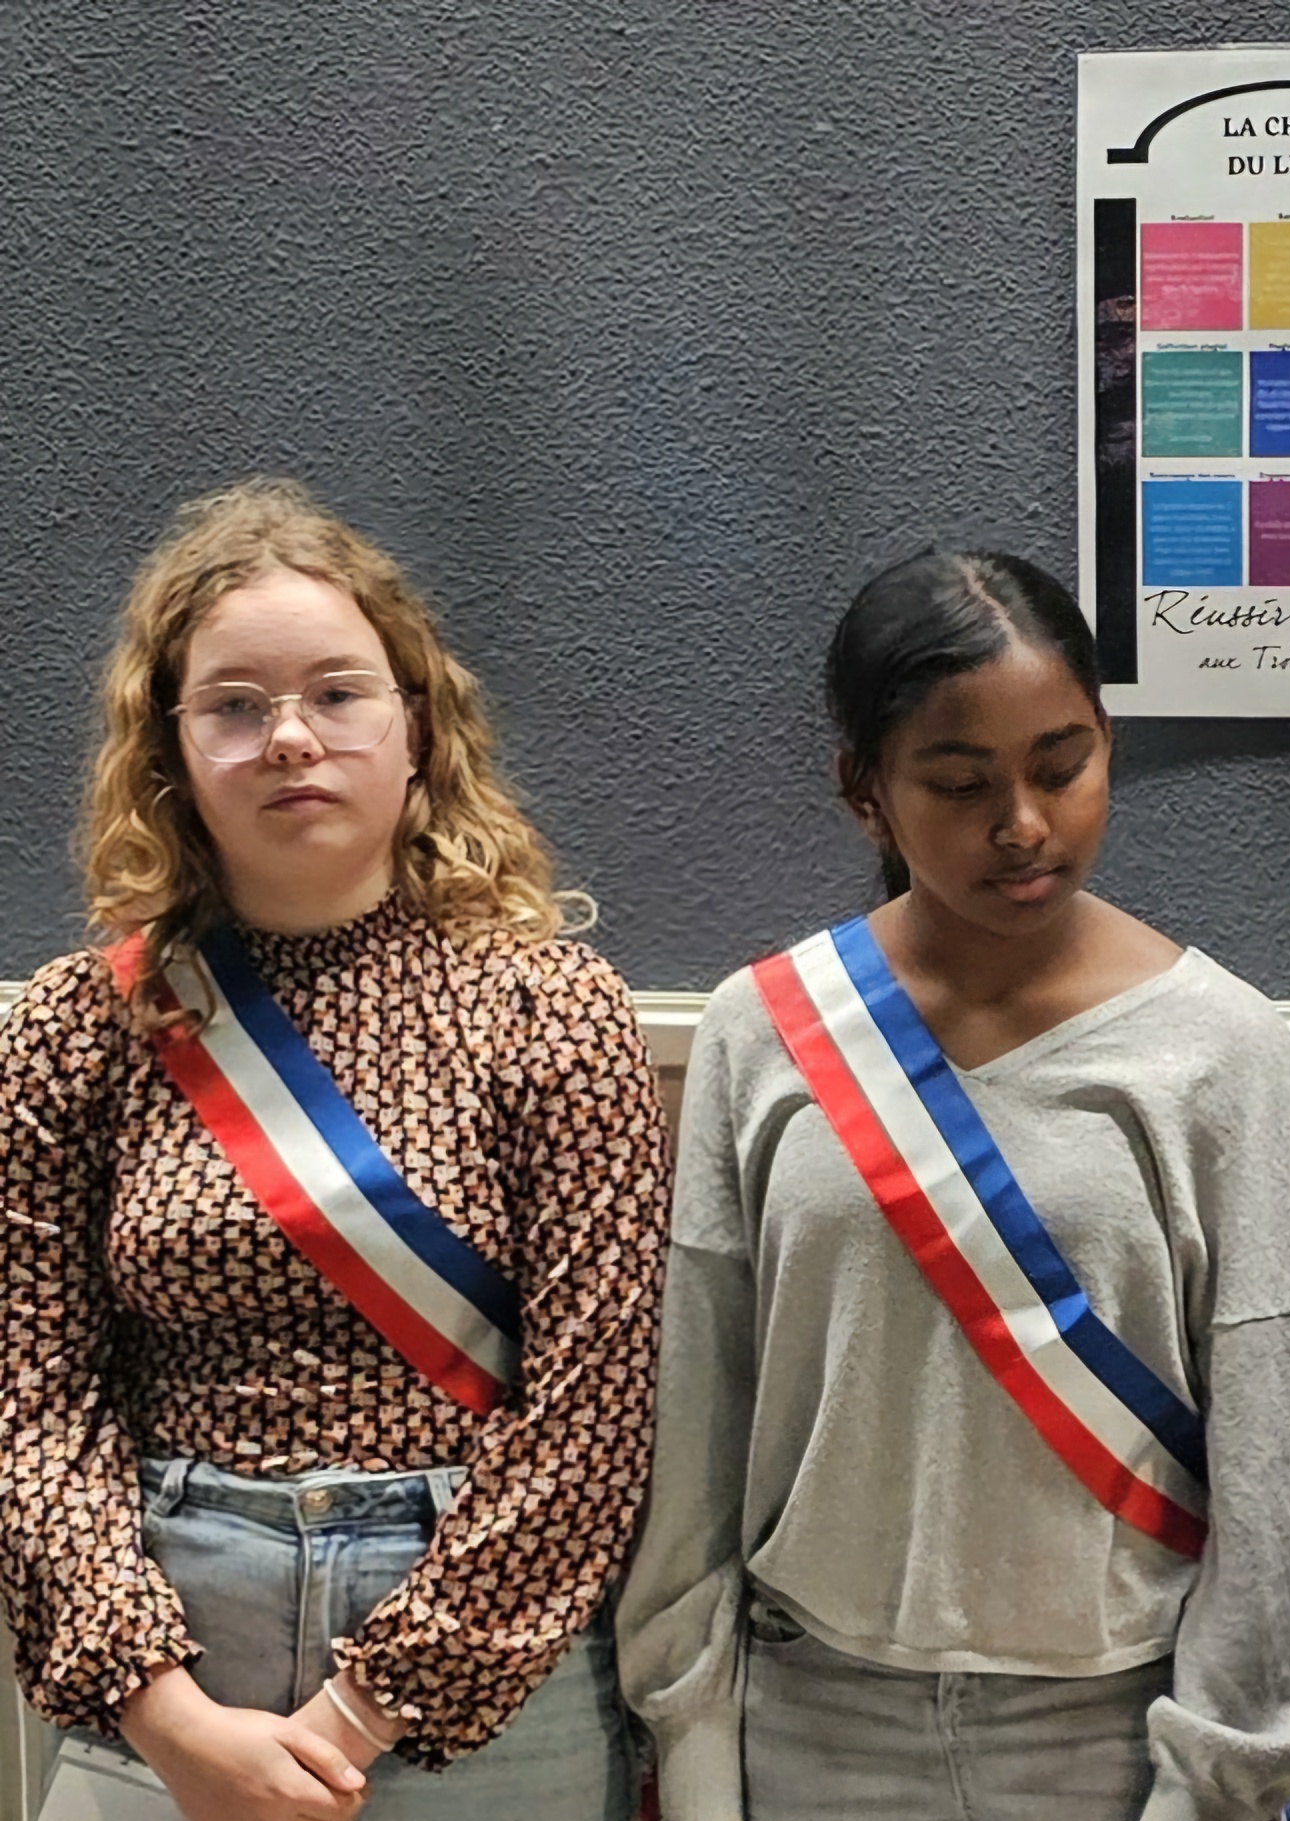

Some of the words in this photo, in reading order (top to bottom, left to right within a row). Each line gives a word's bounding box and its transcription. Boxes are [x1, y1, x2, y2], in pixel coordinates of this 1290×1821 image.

[1223, 117, 1257, 137] LA
[1228, 156, 1264, 175] DU
[1198, 656, 1241, 669] aux
